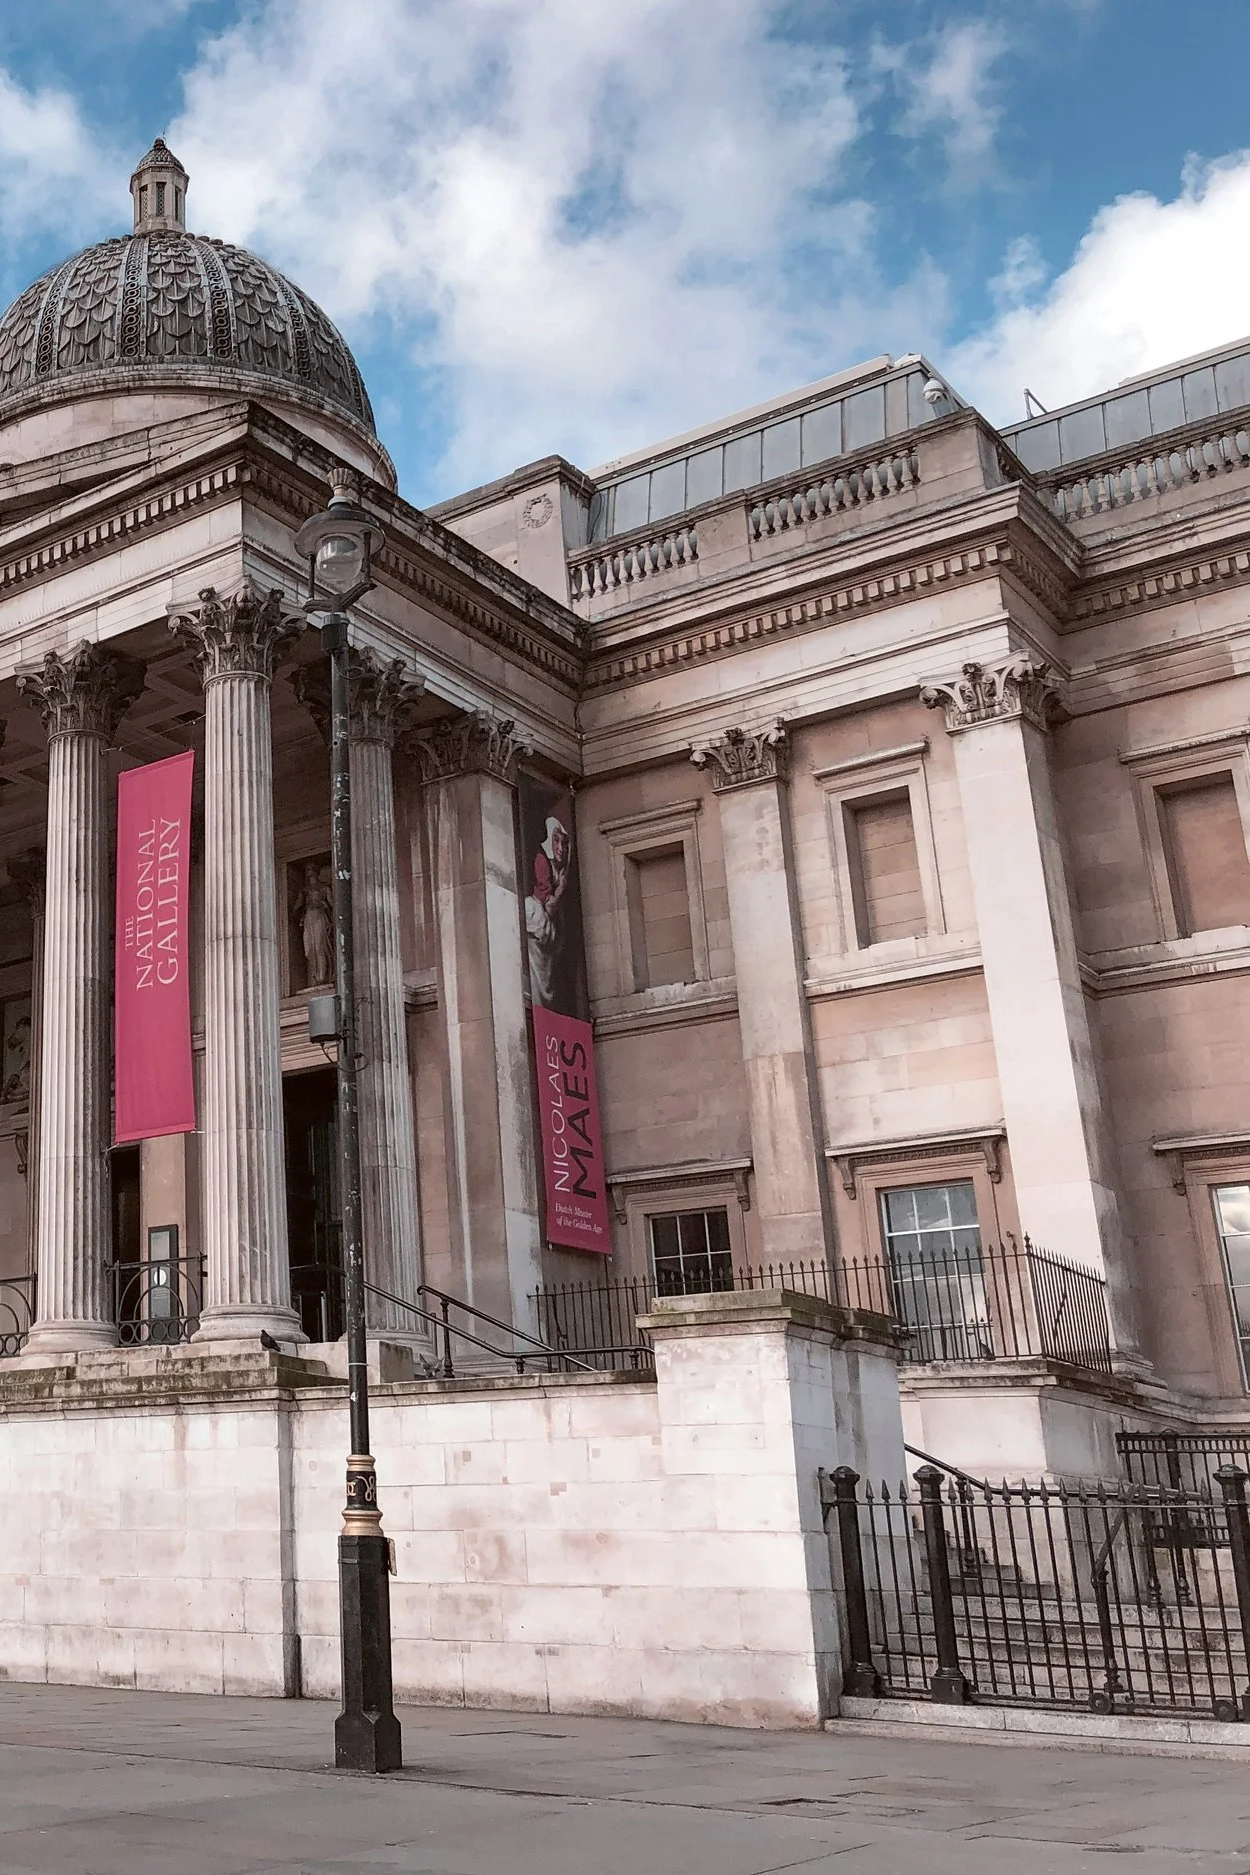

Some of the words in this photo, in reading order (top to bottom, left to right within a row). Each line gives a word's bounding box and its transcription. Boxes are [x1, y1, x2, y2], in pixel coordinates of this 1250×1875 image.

[125, 915, 134, 950] THE
[136, 819, 156, 991] NATIONAL
[157, 817, 181, 985] GALLERY
[546, 1035, 570, 1193] NICOLAES
[559, 1040, 597, 1199] MAES
